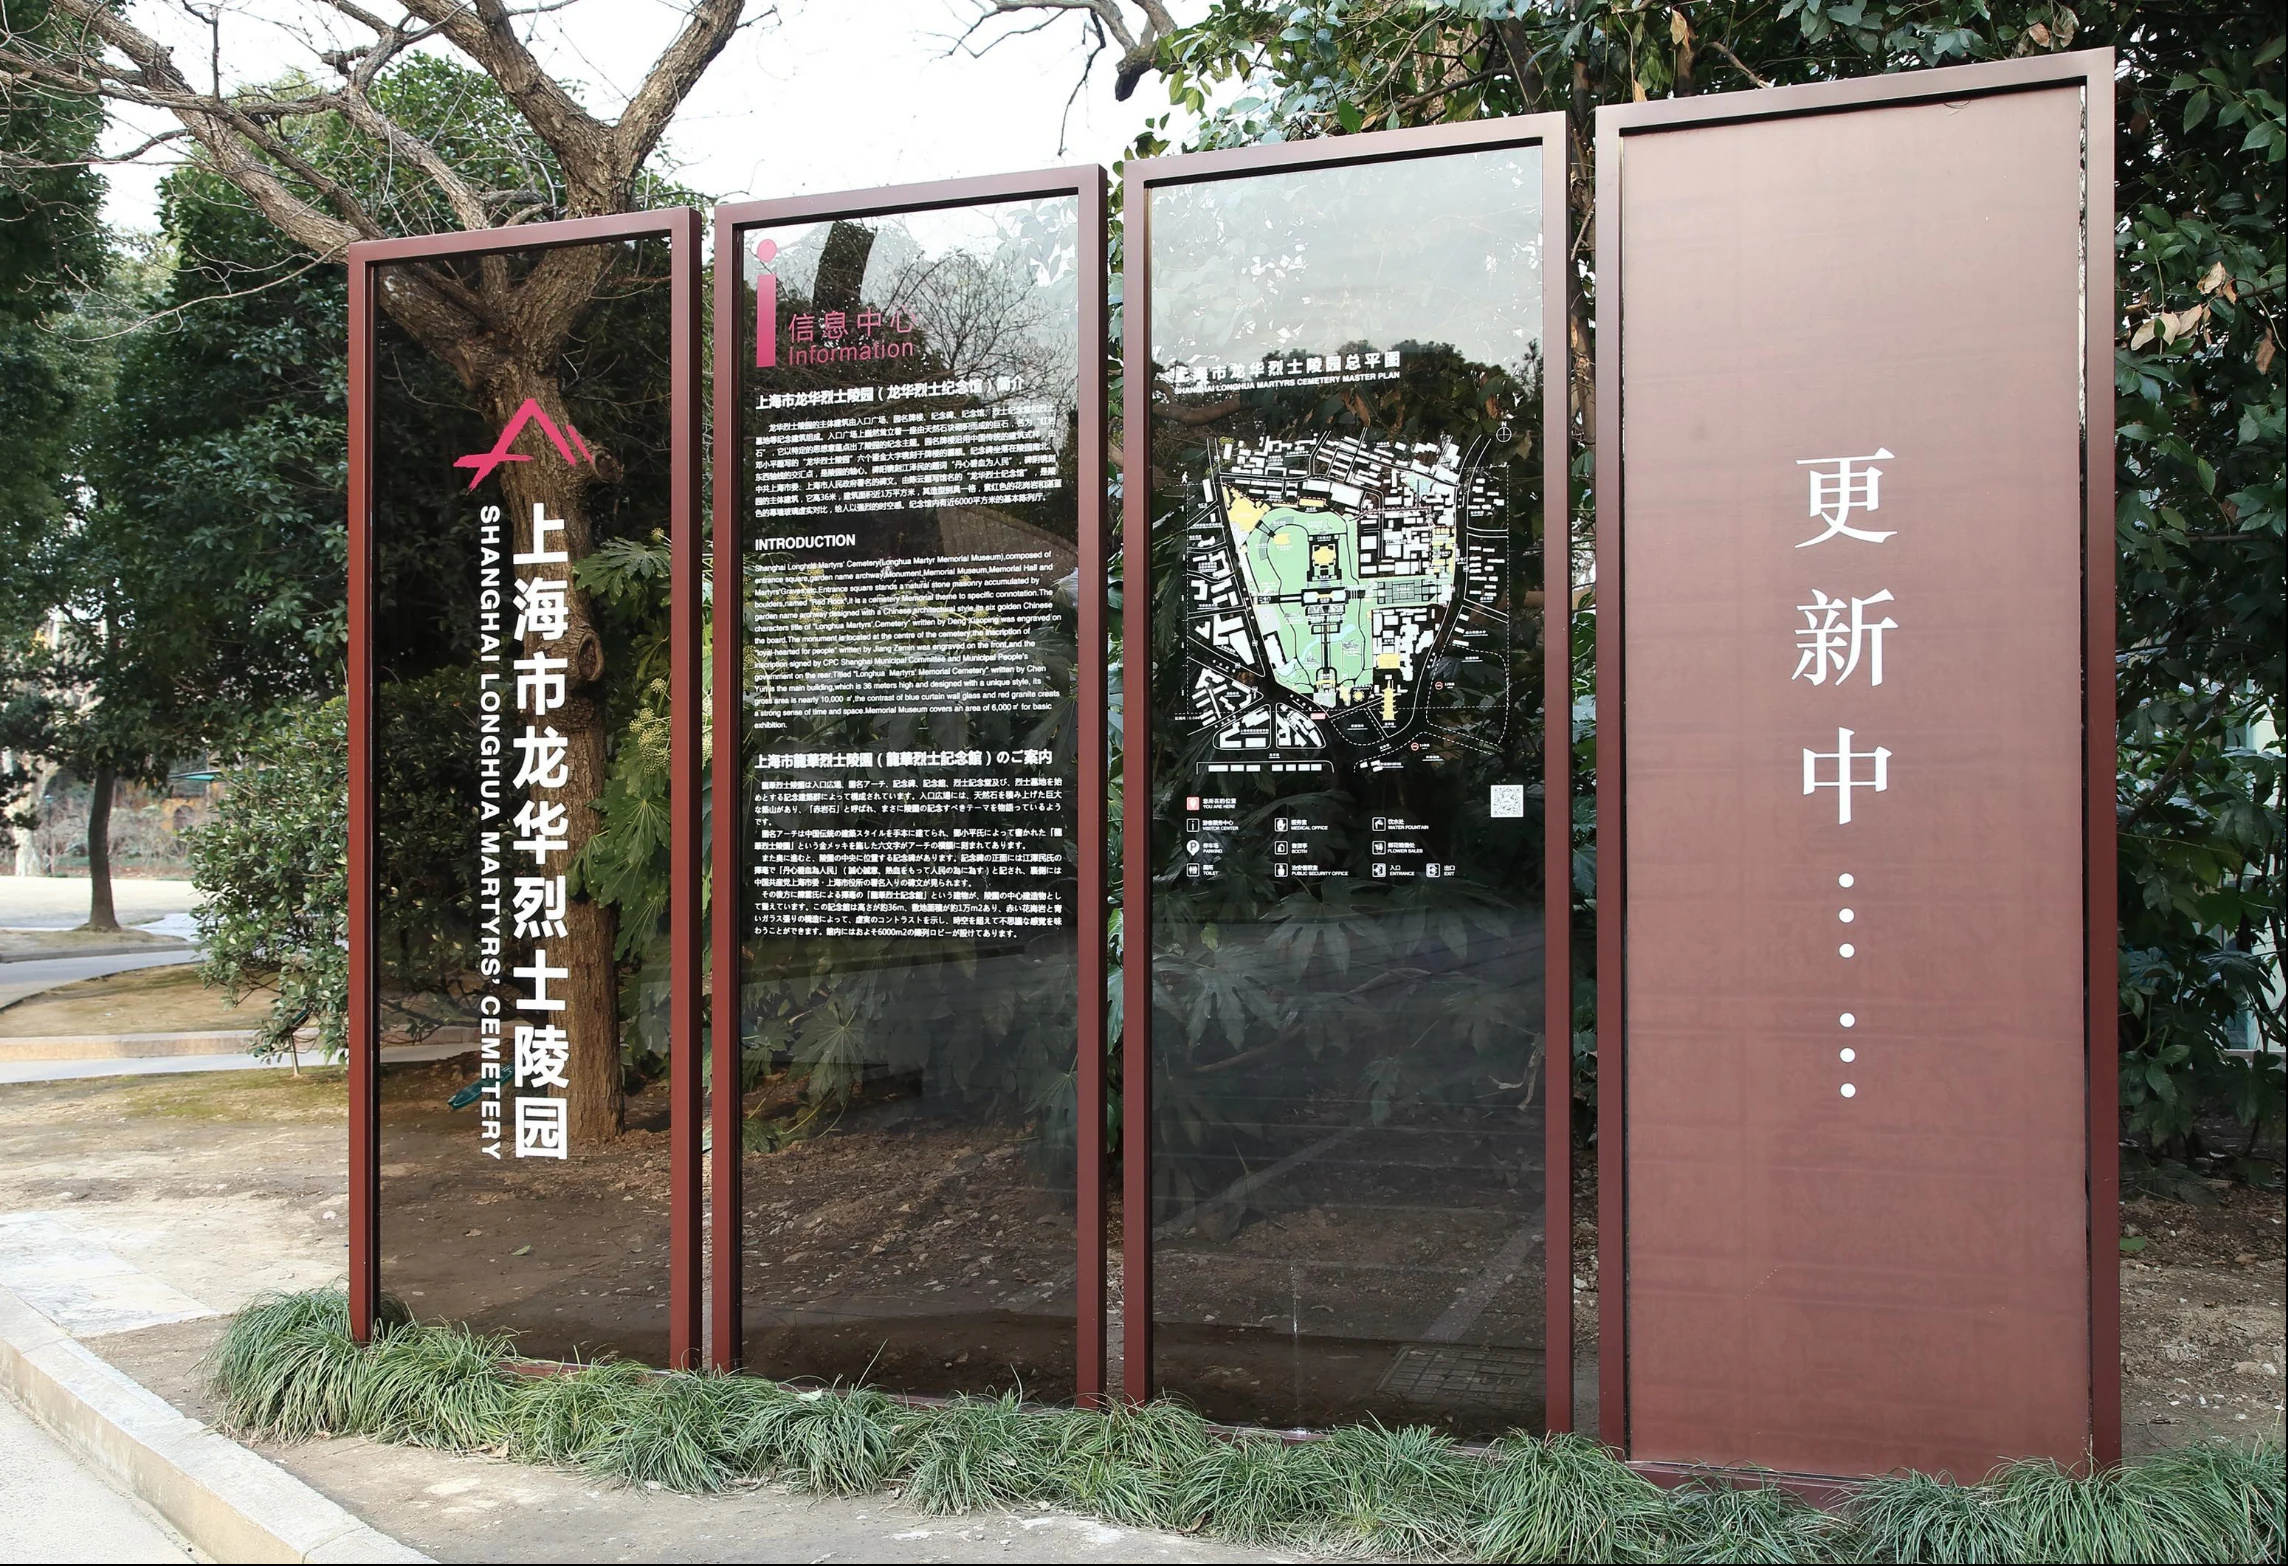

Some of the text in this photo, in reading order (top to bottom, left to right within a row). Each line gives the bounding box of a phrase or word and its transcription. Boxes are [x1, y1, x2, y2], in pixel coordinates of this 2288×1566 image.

[788, 305, 917, 343] 信息中心
[789, 341, 914, 366] Information
[1174, 371, 1400, 395] SHANGHAI LONGHUA MARTYRS CEMETERY MASTER PLAN
[755, 533, 856, 551] INTRODUCTION
[754, 563, 786, 574] Shanghai
[913, 556, 935, 566] Martyr
[937, 555, 970, 563] Memorial
[754, 575, 784, 584] entrance
[1023, 564, 1038, 572] Hall
[1039, 563, 1053, 571] and
[754, 624, 790, 632] characters
[790, 623, 803, 631] title
[912, 618, 936, 626] written
[936, 618, 946, 627] by
[947, 617, 967, 627] Deng
[1016, 614, 1051, 624] engraved
[789, 659, 812, 669] signed
[812, 659, 822, 668] by
[822, 658, 840, 666] CPC
[840, 657, 873, 667] Shanghai
[874, 656, 907, 666] Municipal
[908, 655, 946, 664] Committee
[962, 654, 996, 664] Municipal
[997, 653, 1029, 663] People's
[918, 667, 951, 675] Memorial
[990, 665, 1015, 673] written
[1015, 665, 1025, 675] by
[776, 684, 788, 692] the
[855, 682, 862, 690] is
[862, 682, 872, 690] 36
[873, 681, 897, 689] meters
[898, 681, 914, 691] high
[930, 680, 962, 690] designed
[963, 679, 978, 687] with
[986, 679, 1010, 688] unique
[760, 709, 782, 718] strong
[804, 708, 812, 716] of
[828, 707, 842, 715] and
[898, 706, 928, 714] Museum
[982, 704, 990, 712] of
[1021, 703, 1031, 711] for
[1032, 703, 1052, 711] basic
[754, 720, 788, 728] exhibition.
[513, 502, 569, 1160] 上海市龙华烈士陵园
[754, 817, 772, 827] です。
[480, 505, 501, 1160] SHANGHAI LONGHUA MARTYRS' CEMETERY
